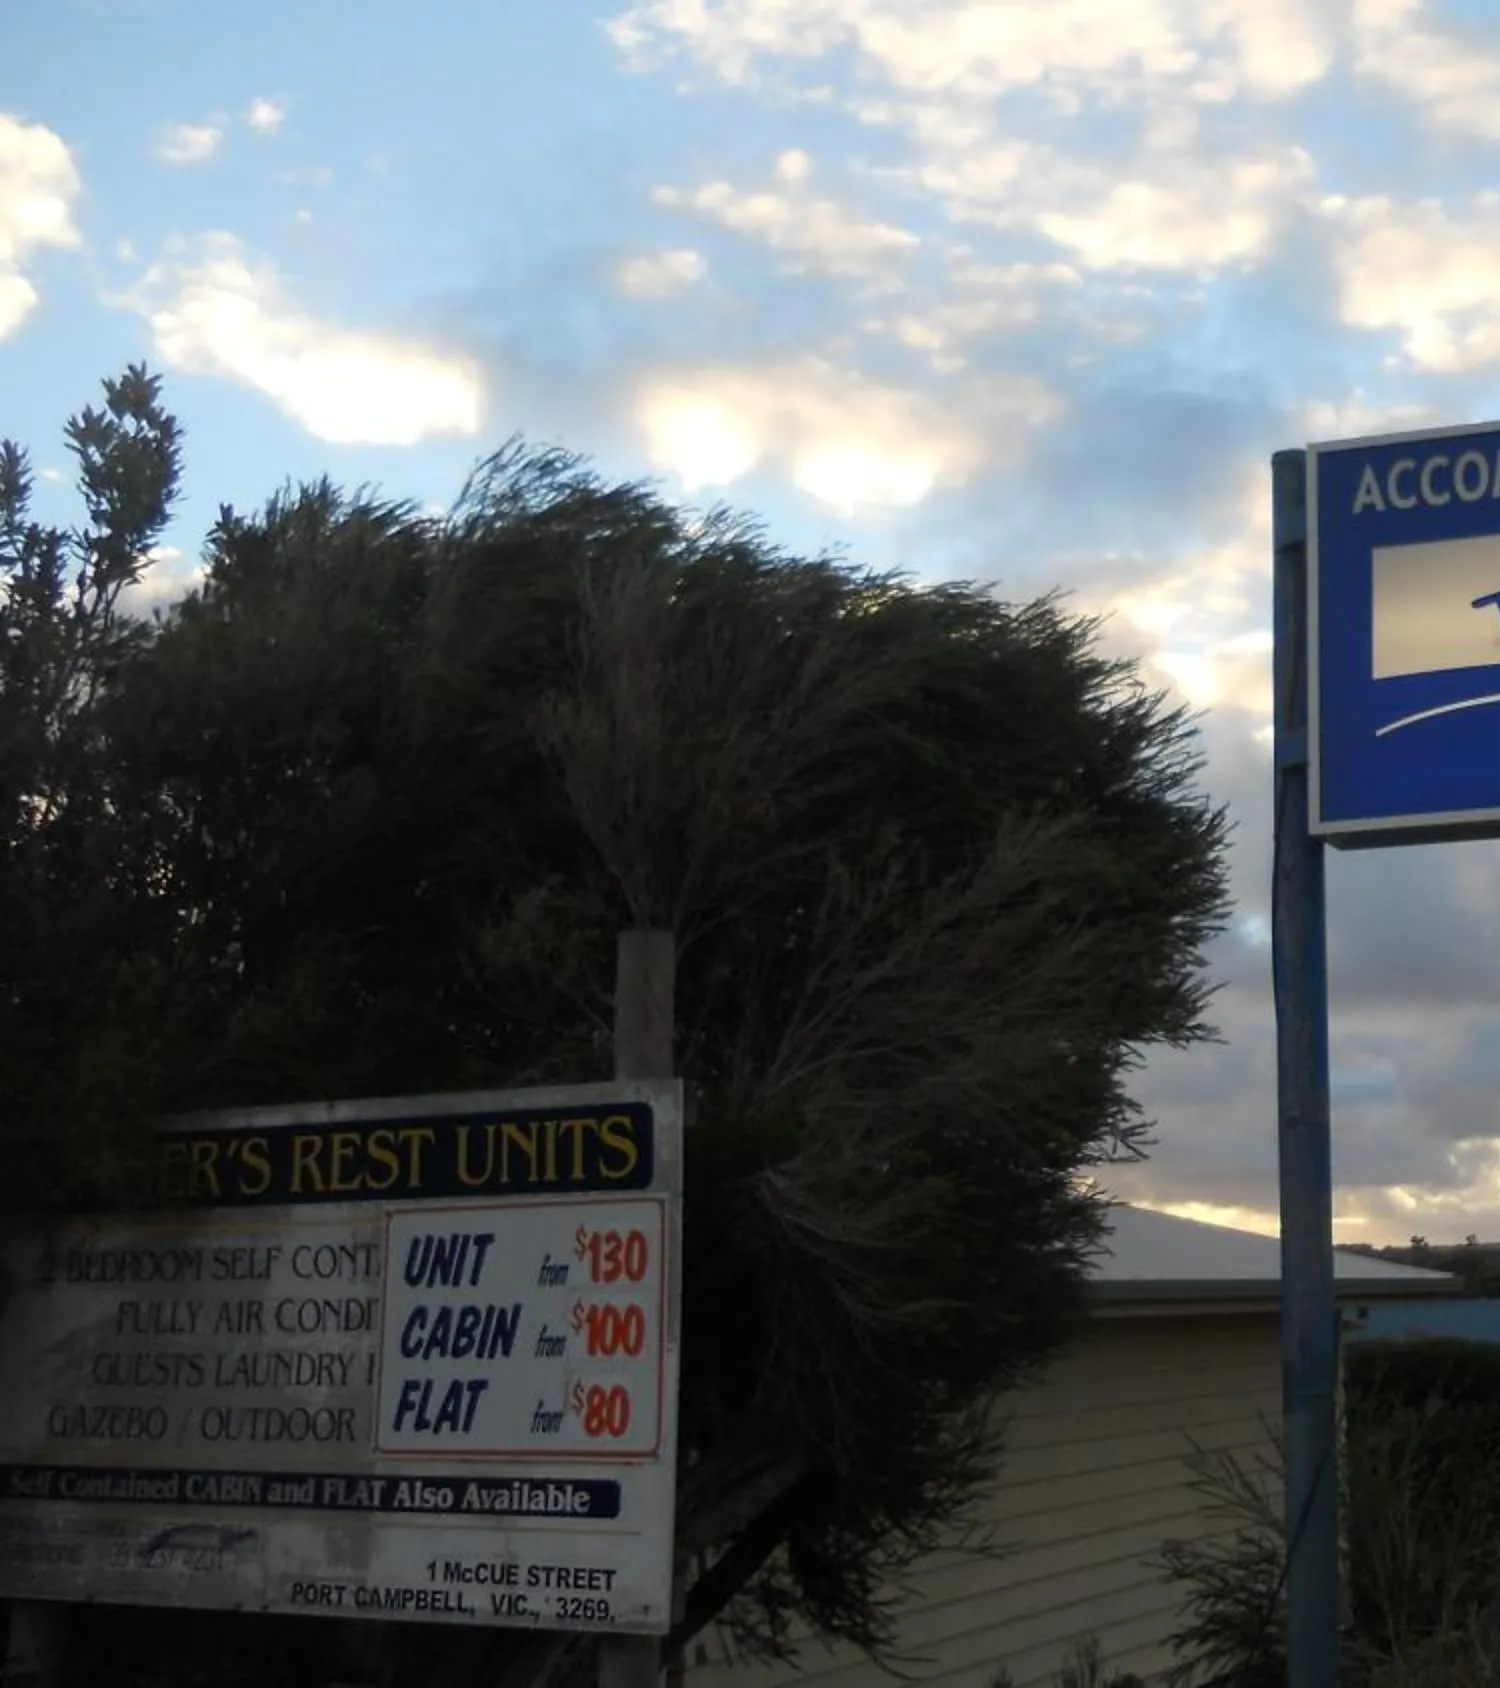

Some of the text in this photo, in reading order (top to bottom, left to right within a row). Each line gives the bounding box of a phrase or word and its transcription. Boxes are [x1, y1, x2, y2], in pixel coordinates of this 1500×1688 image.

[288, 1127, 435, 1192] REST
[455, 1114, 641, 1187] UNITS
[211, 1247, 281, 1280] SELF
[404, 1224, 648, 1287] UNIT from $130
[116, 1299, 203, 1335] FULLY
[213, 1299, 266, 1334] AIR
[400, 1298, 645, 1359] CABIN from $100
[92, 1353, 205, 1388] GUESTS
[215, 1352, 356, 1387] LAUNDRY
[47, 1403, 169, 1440] GAZEBO
[200, 1405, 357, 1441] OUTDOOR
[393, 1377, 632, 1437] FLAT from $80
[60, 1472, 178, 1501] Contained
[186, 1475, 262, 1501] CABIN
[268, 1477, 314, 1504] and
[322, 1479, 387, 1507] FLAT
[393, 1480, 454, 1510] Also
[461, 1481, 592, 1514] Available
[427, 1560, 617, 1591] 1 McCUE STREET
[291, 1582, 346, 1606] PORT
[355, 1586, 476, 1616] CAMPBELL,
